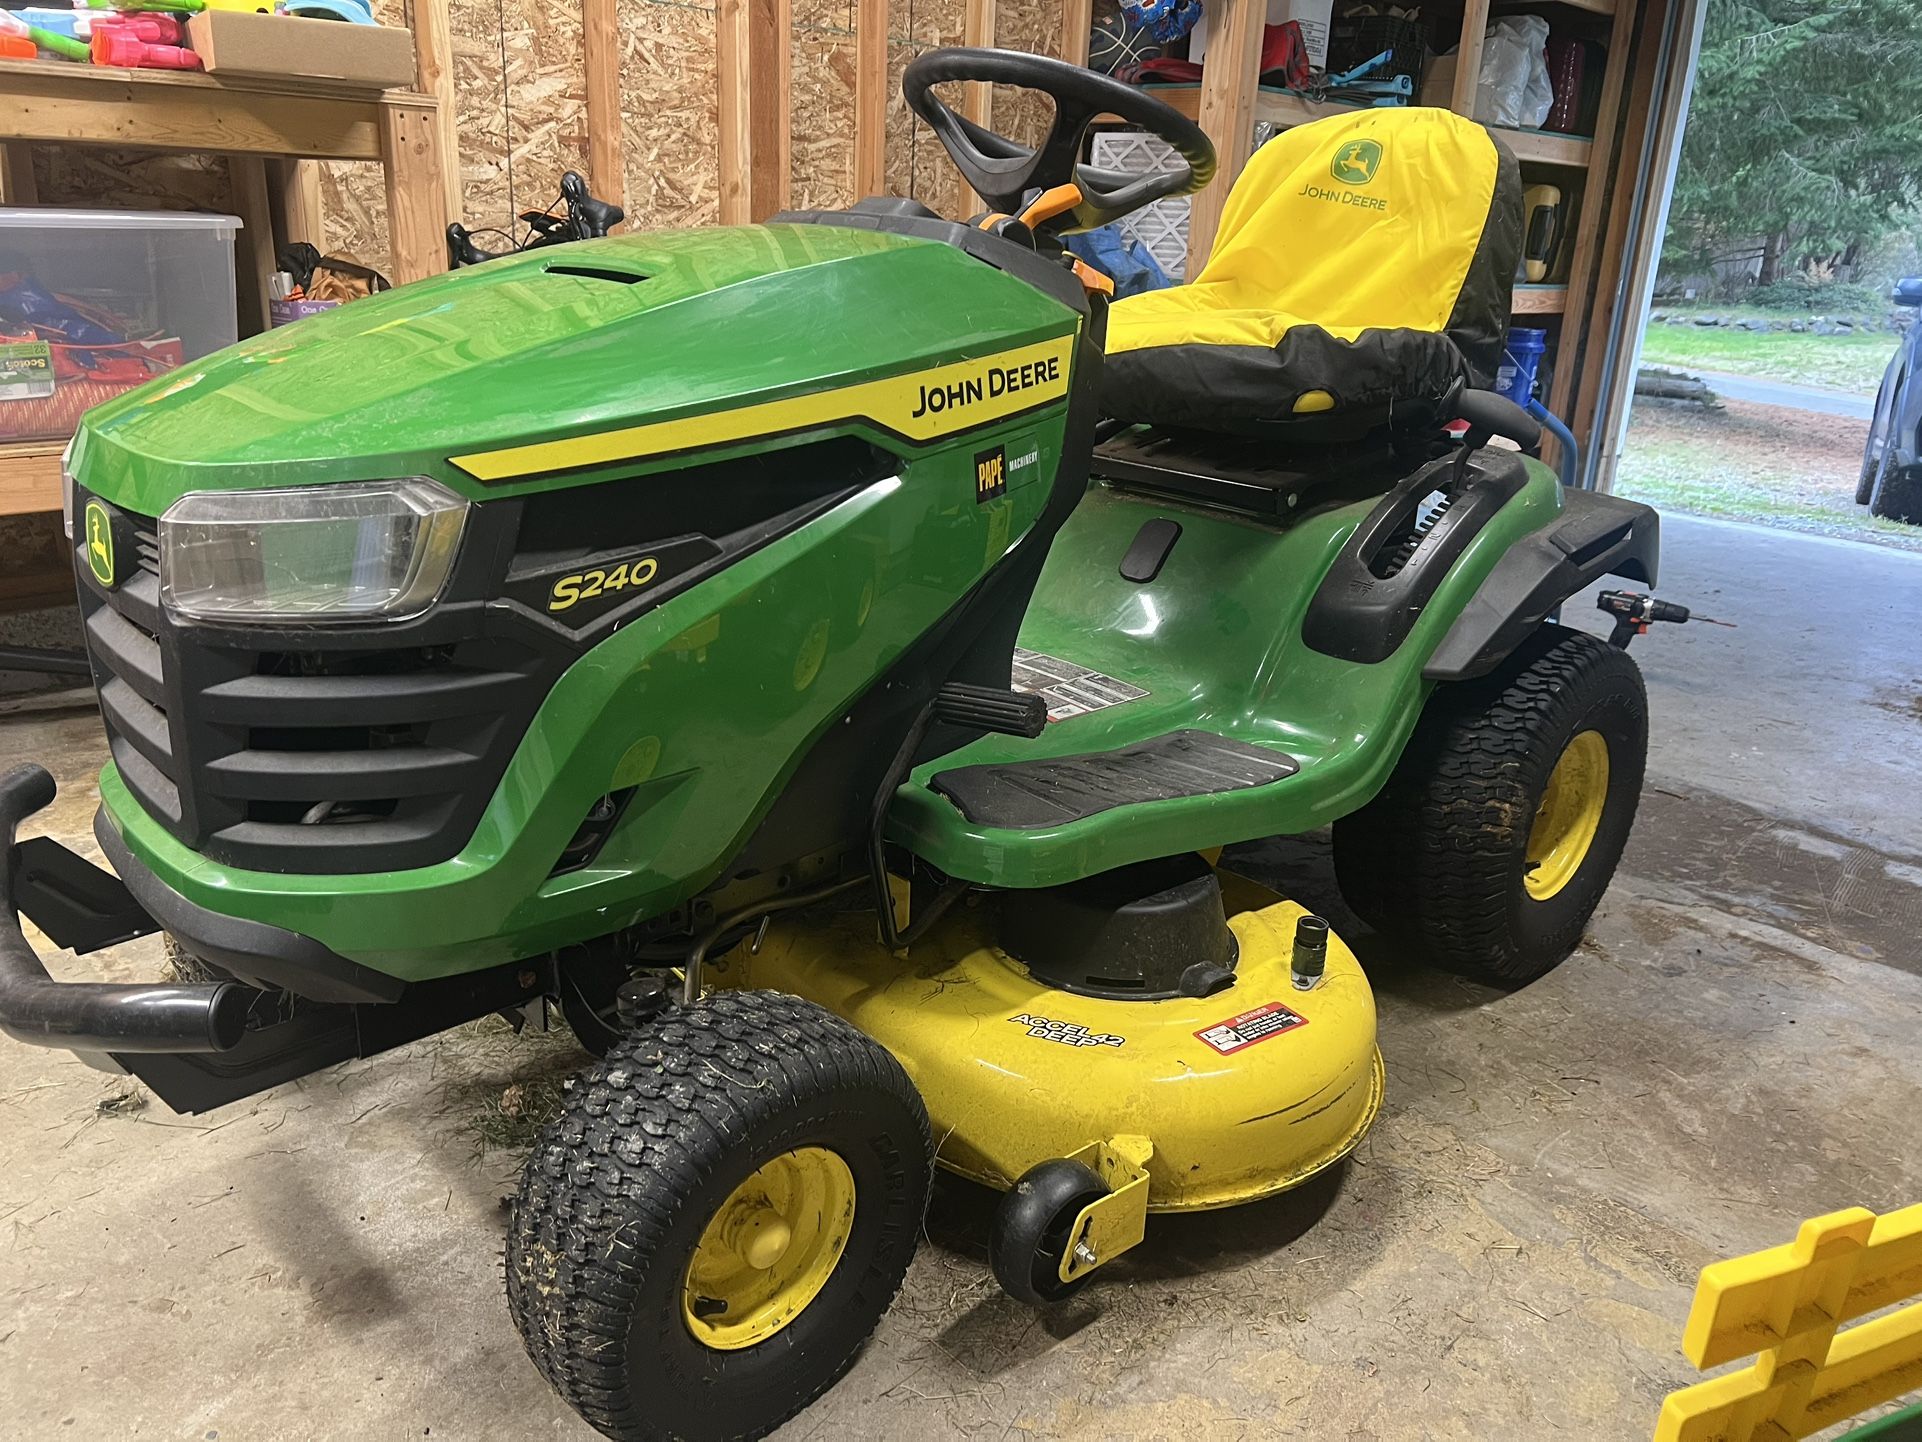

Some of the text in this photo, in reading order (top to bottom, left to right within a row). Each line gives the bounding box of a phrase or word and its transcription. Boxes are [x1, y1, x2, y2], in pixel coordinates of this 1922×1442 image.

[1298, 184, 1387, 210] JOHN DEERE
[912, 356, 1060, 418] JOHN DEERE
[1009, 450, 1038, 472] MACHINERY
[549, 558, 658, 610] S240
[1007, 1013, 1125, 1047] ACCEL 42
[1026, 1026, 1098, 1047] DEEP
